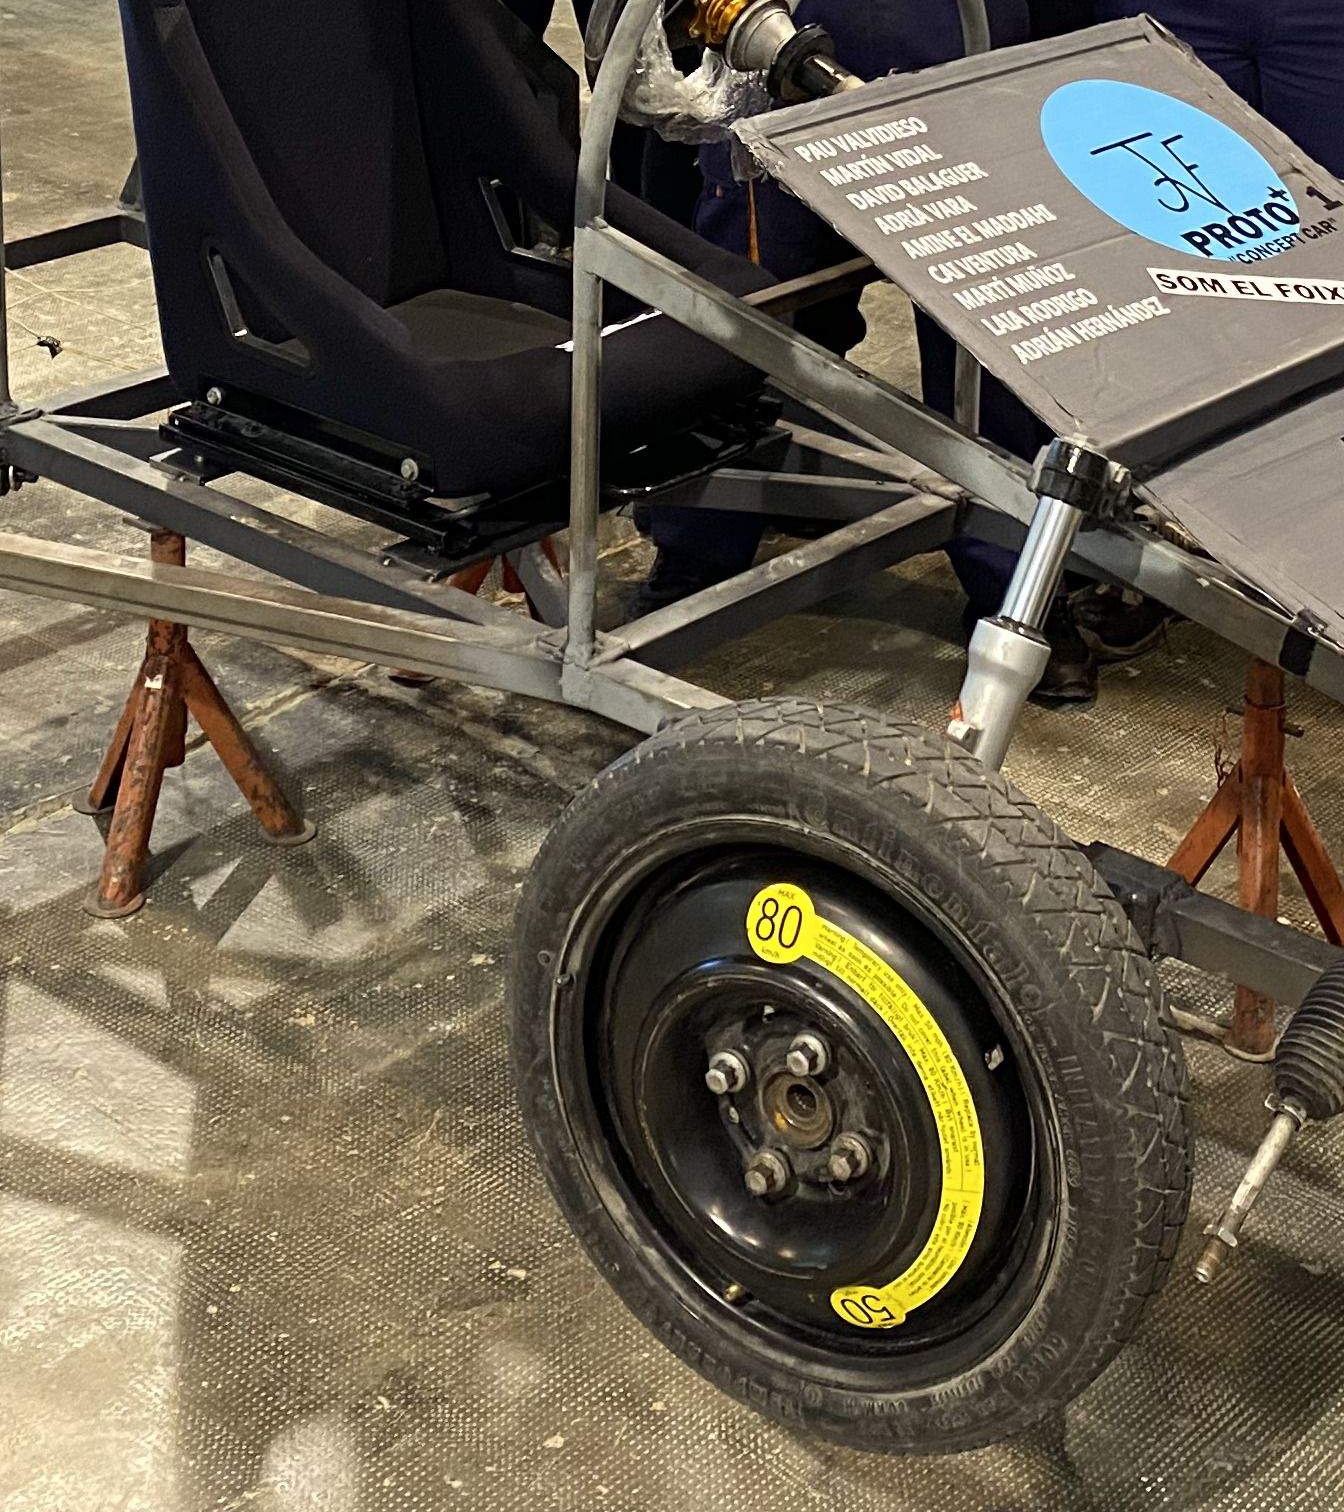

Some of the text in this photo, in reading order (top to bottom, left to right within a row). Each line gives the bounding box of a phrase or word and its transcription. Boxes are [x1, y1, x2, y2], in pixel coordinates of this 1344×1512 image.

[793, 116, 929, 163] PAU VALVIDIESO
[819, 143, 943, 187] MARTÍN VIDAL
[845, 161, 989, 211] DAVID BALAGUER
[901, 203, 1057, 260] AMINE EL MADDAHI
[923, 195, 978, 221] VARA
[956, 241, 1038, 274] VENTURA
[952, 262, 1076, 311] MARTÍ MUÑOZ
[1155, 272, 1227, 295] SOM
[1232, 279, 1270, 298] EL
[980, 287, 1098, 337] LAIA RODRIGO
[1010, 295, 1172, 365] ADRIÁN HERNÁNDEZ
[755, 897, 802, 949] 80
[840, 1294, 895, 1324] 50
